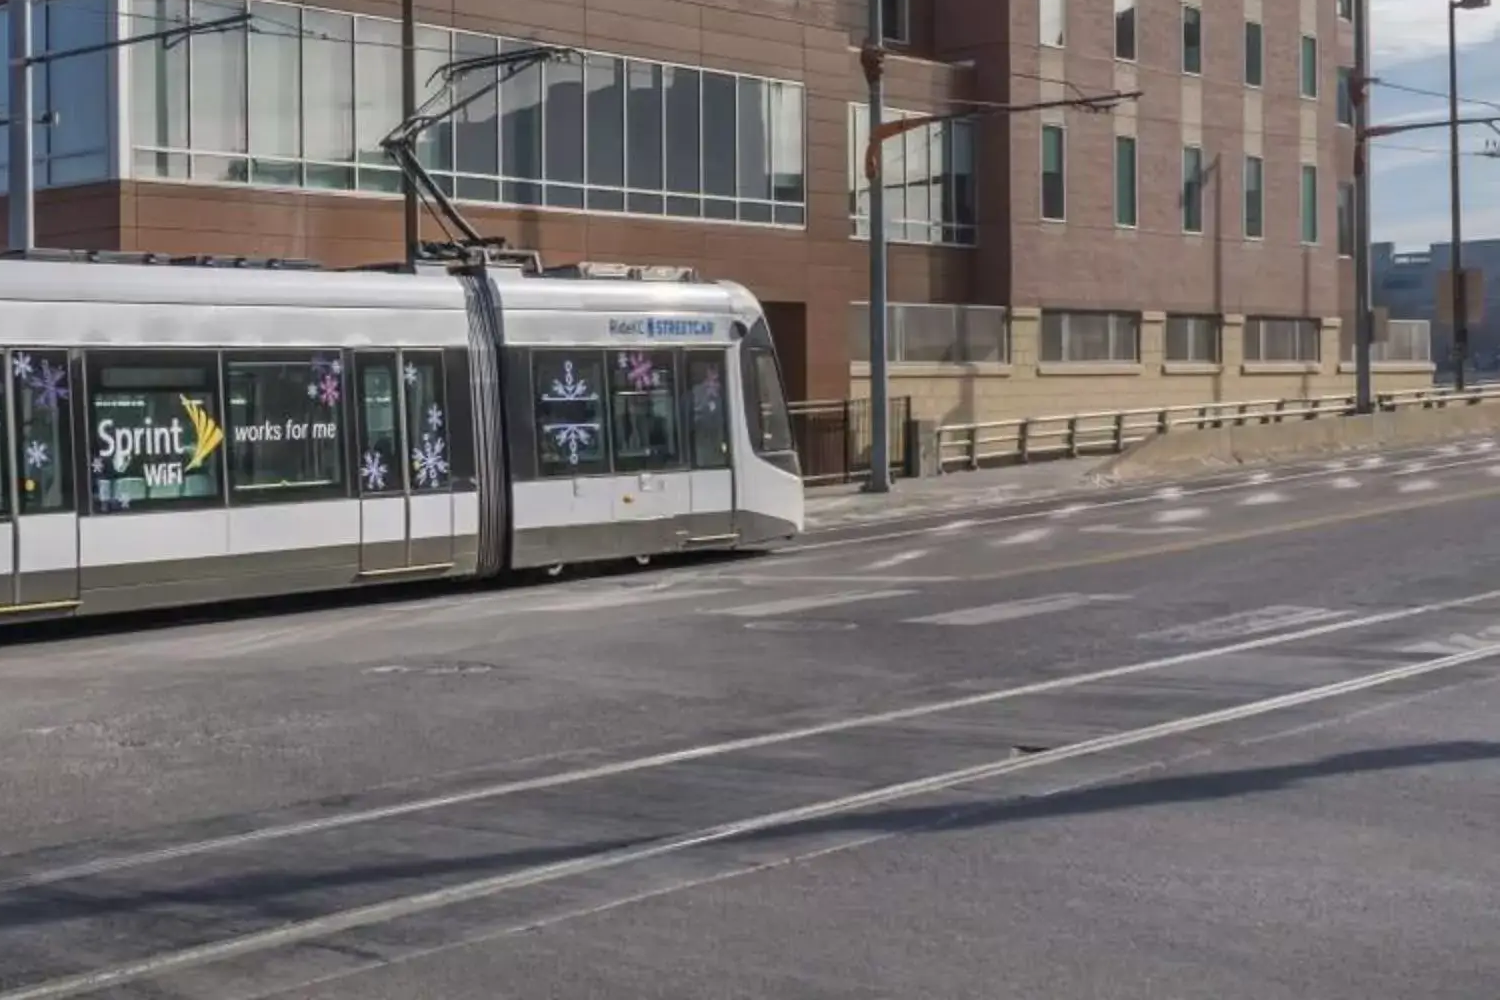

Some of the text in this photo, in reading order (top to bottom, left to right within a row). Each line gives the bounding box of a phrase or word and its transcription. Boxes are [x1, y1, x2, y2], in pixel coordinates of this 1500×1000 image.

[97, 416, 338, 473] Sprint works for me
[143, 462, 183, 487] WiFi
